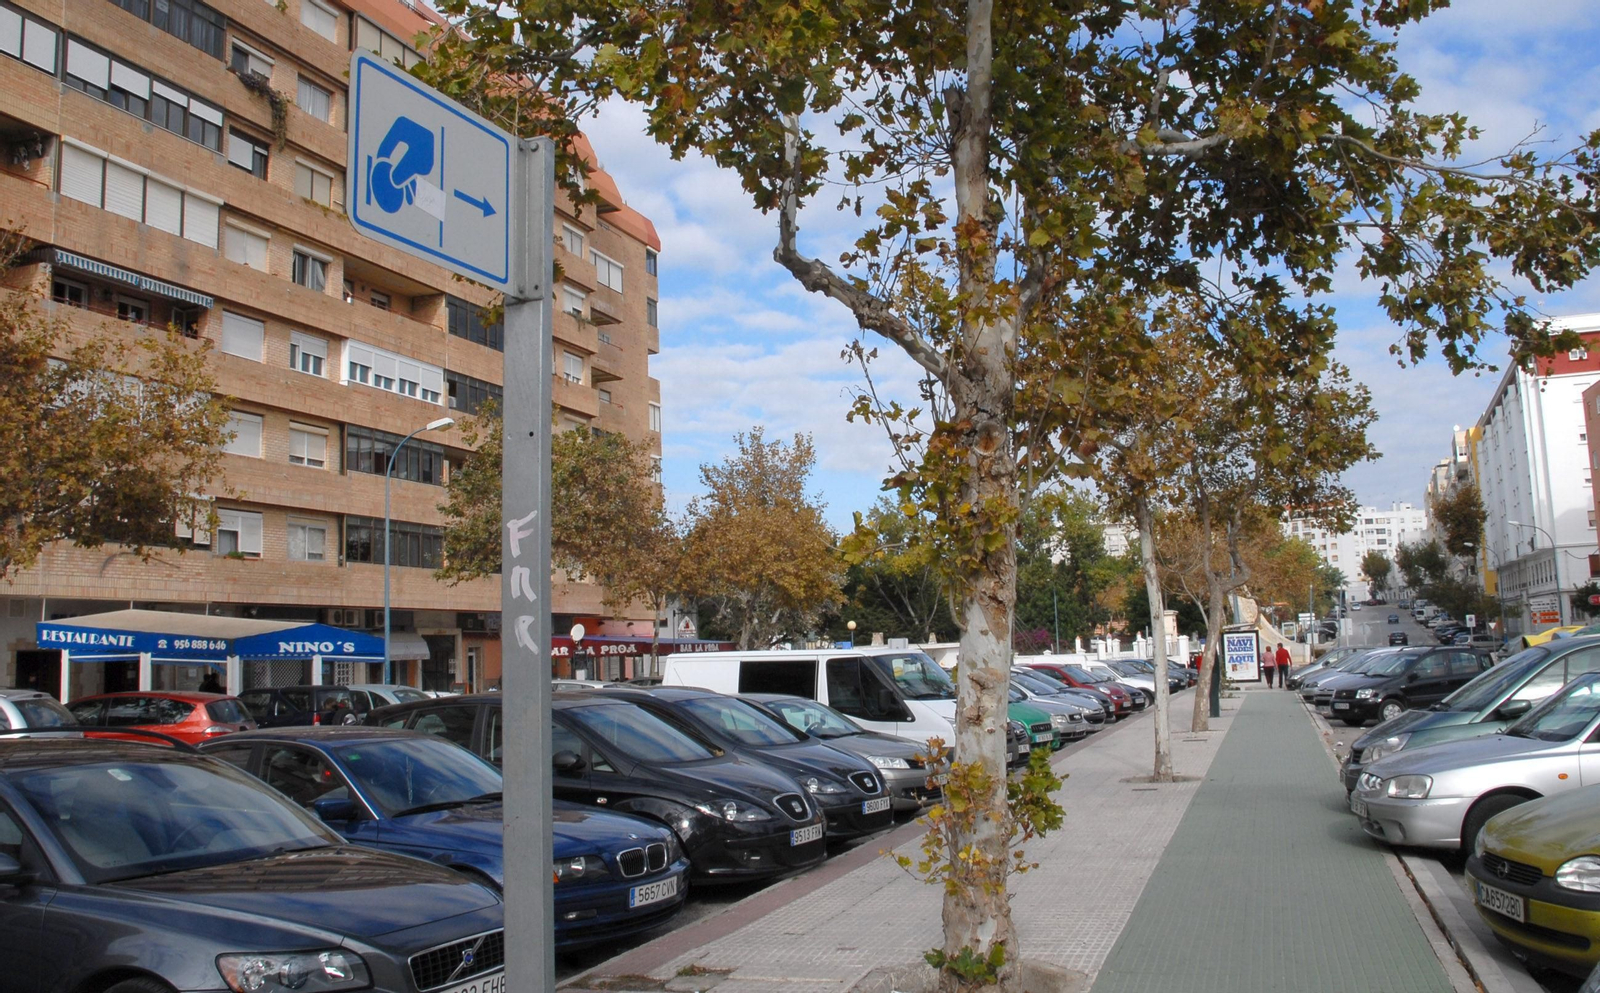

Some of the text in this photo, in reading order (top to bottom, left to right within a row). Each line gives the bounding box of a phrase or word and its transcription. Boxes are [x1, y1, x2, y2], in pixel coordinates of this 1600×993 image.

[42, 629, 227, 651] RESTAURANTE 956 888 646
[551, 646, 569, 656] AR
[600, 643, 637, 655] PROA
[794, 828, 810, 843] 9513
[638, 884, 660, 902] 5657
